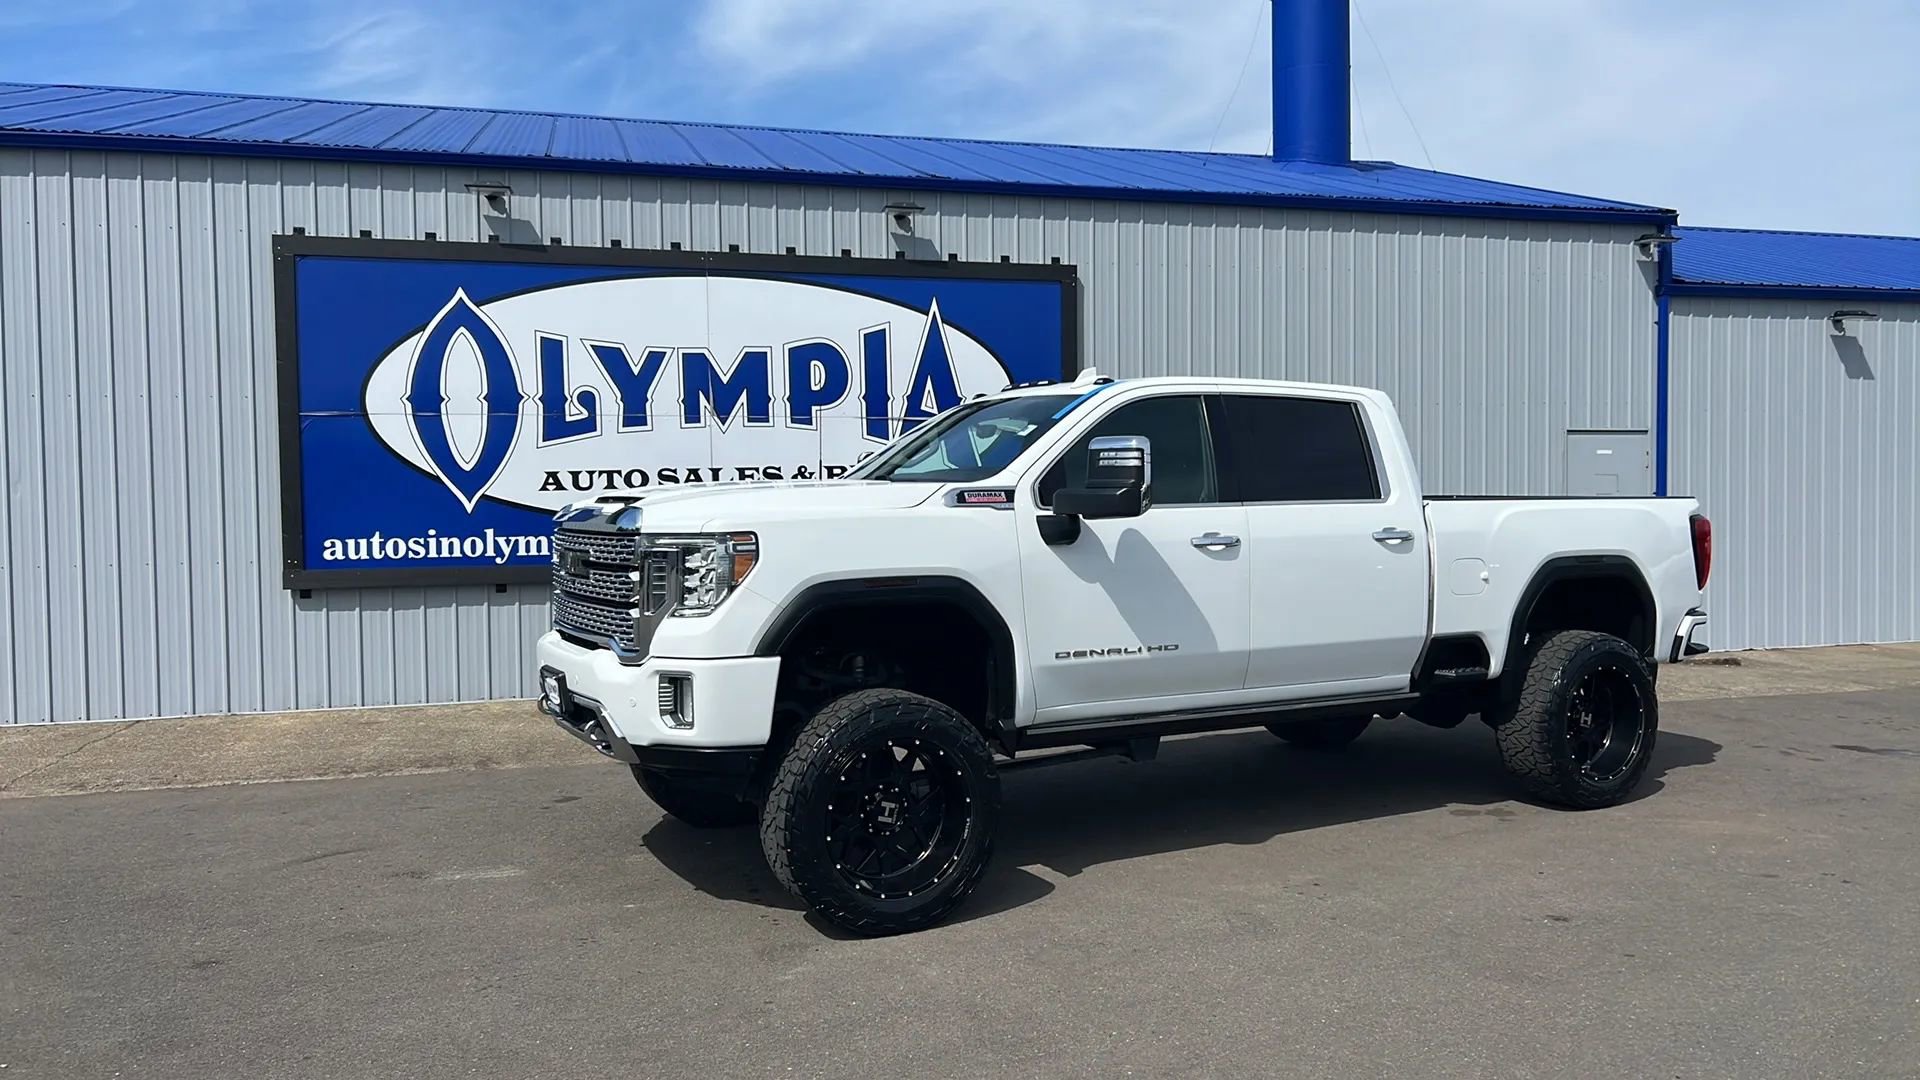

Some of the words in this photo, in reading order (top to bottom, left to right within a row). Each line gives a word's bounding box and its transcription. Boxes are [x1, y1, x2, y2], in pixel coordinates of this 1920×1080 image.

[400, 286, 967, 513] OLYMPIA
[538, 468, 650, 491] AUTO
[1055, 645, 1142, 659] DENALI
[1146, 643, 1180, 653] HD
